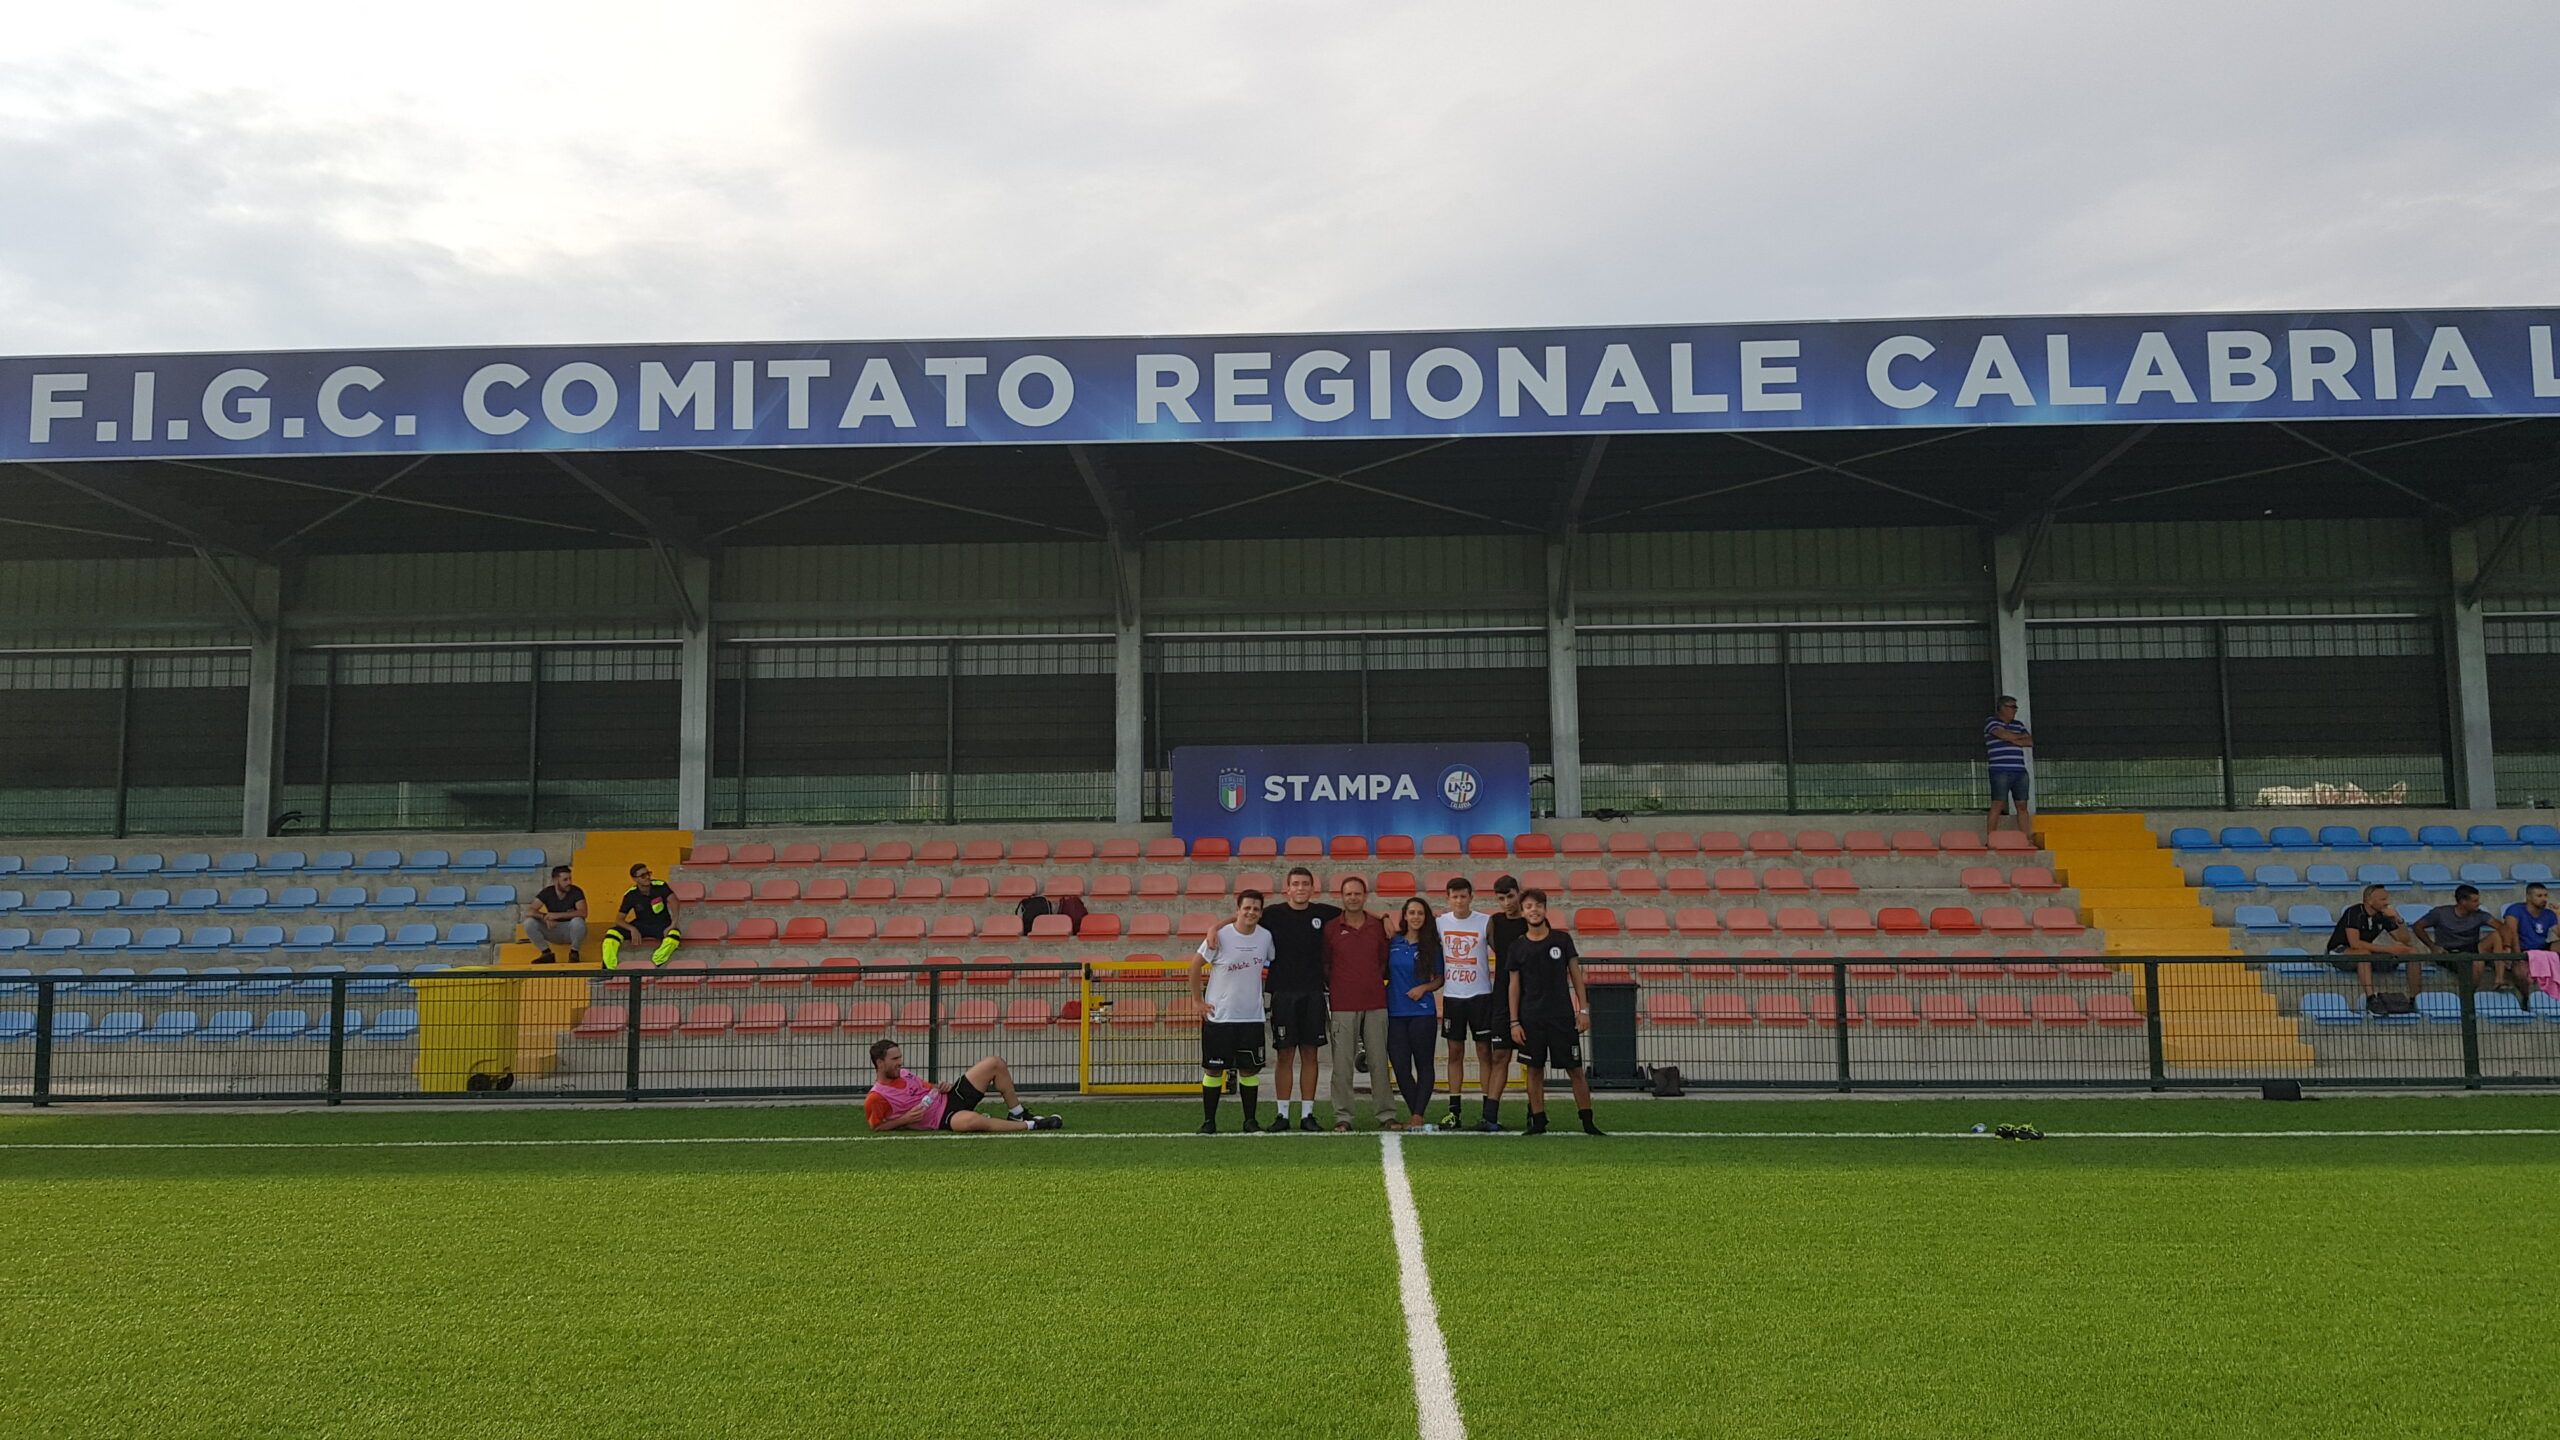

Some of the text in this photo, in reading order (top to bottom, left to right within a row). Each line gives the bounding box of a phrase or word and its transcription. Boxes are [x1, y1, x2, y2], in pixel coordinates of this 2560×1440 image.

[29, 365, 416, 443] F.I.G.C.
[462, 354, 1075, 436] COMITATO
[1136, 339, 1802, 424] REGIONALE
[1865, 326, 2494, 409] CALABRIA
[1263, 773, 1420, 802] STAMPA
